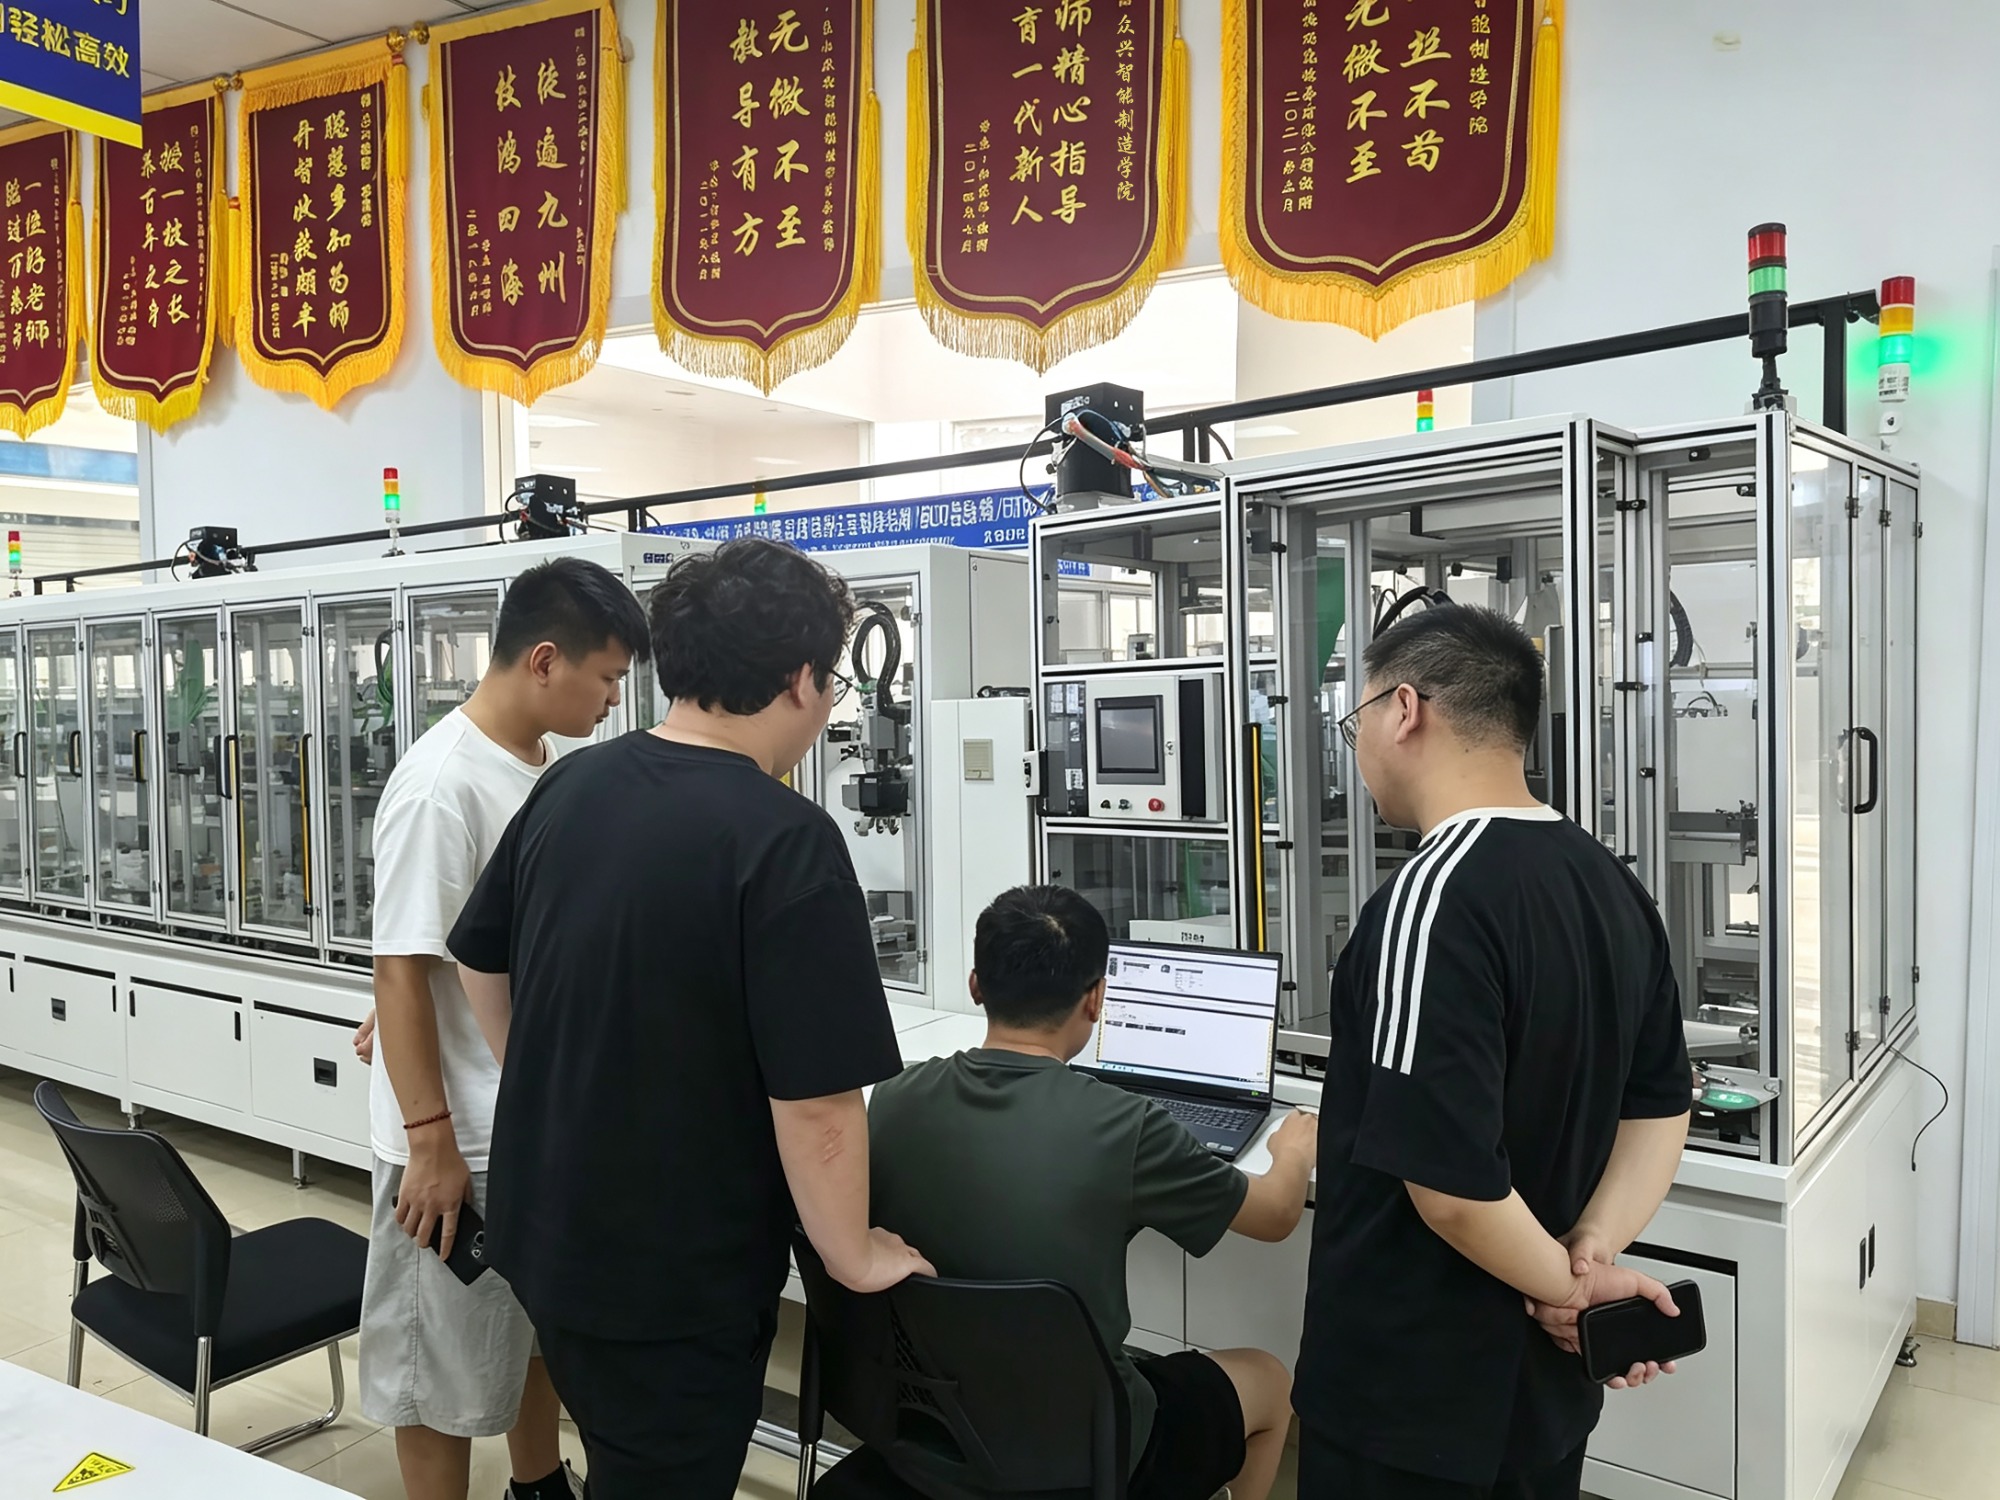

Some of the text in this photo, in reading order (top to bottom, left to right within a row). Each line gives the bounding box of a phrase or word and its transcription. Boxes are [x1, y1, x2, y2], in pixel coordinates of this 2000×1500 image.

[729, 18, 765, 258] 教导有方
[768, 9, 811, 250] 无微不至
[1008, 6, 1045, 226] 育一代新人
